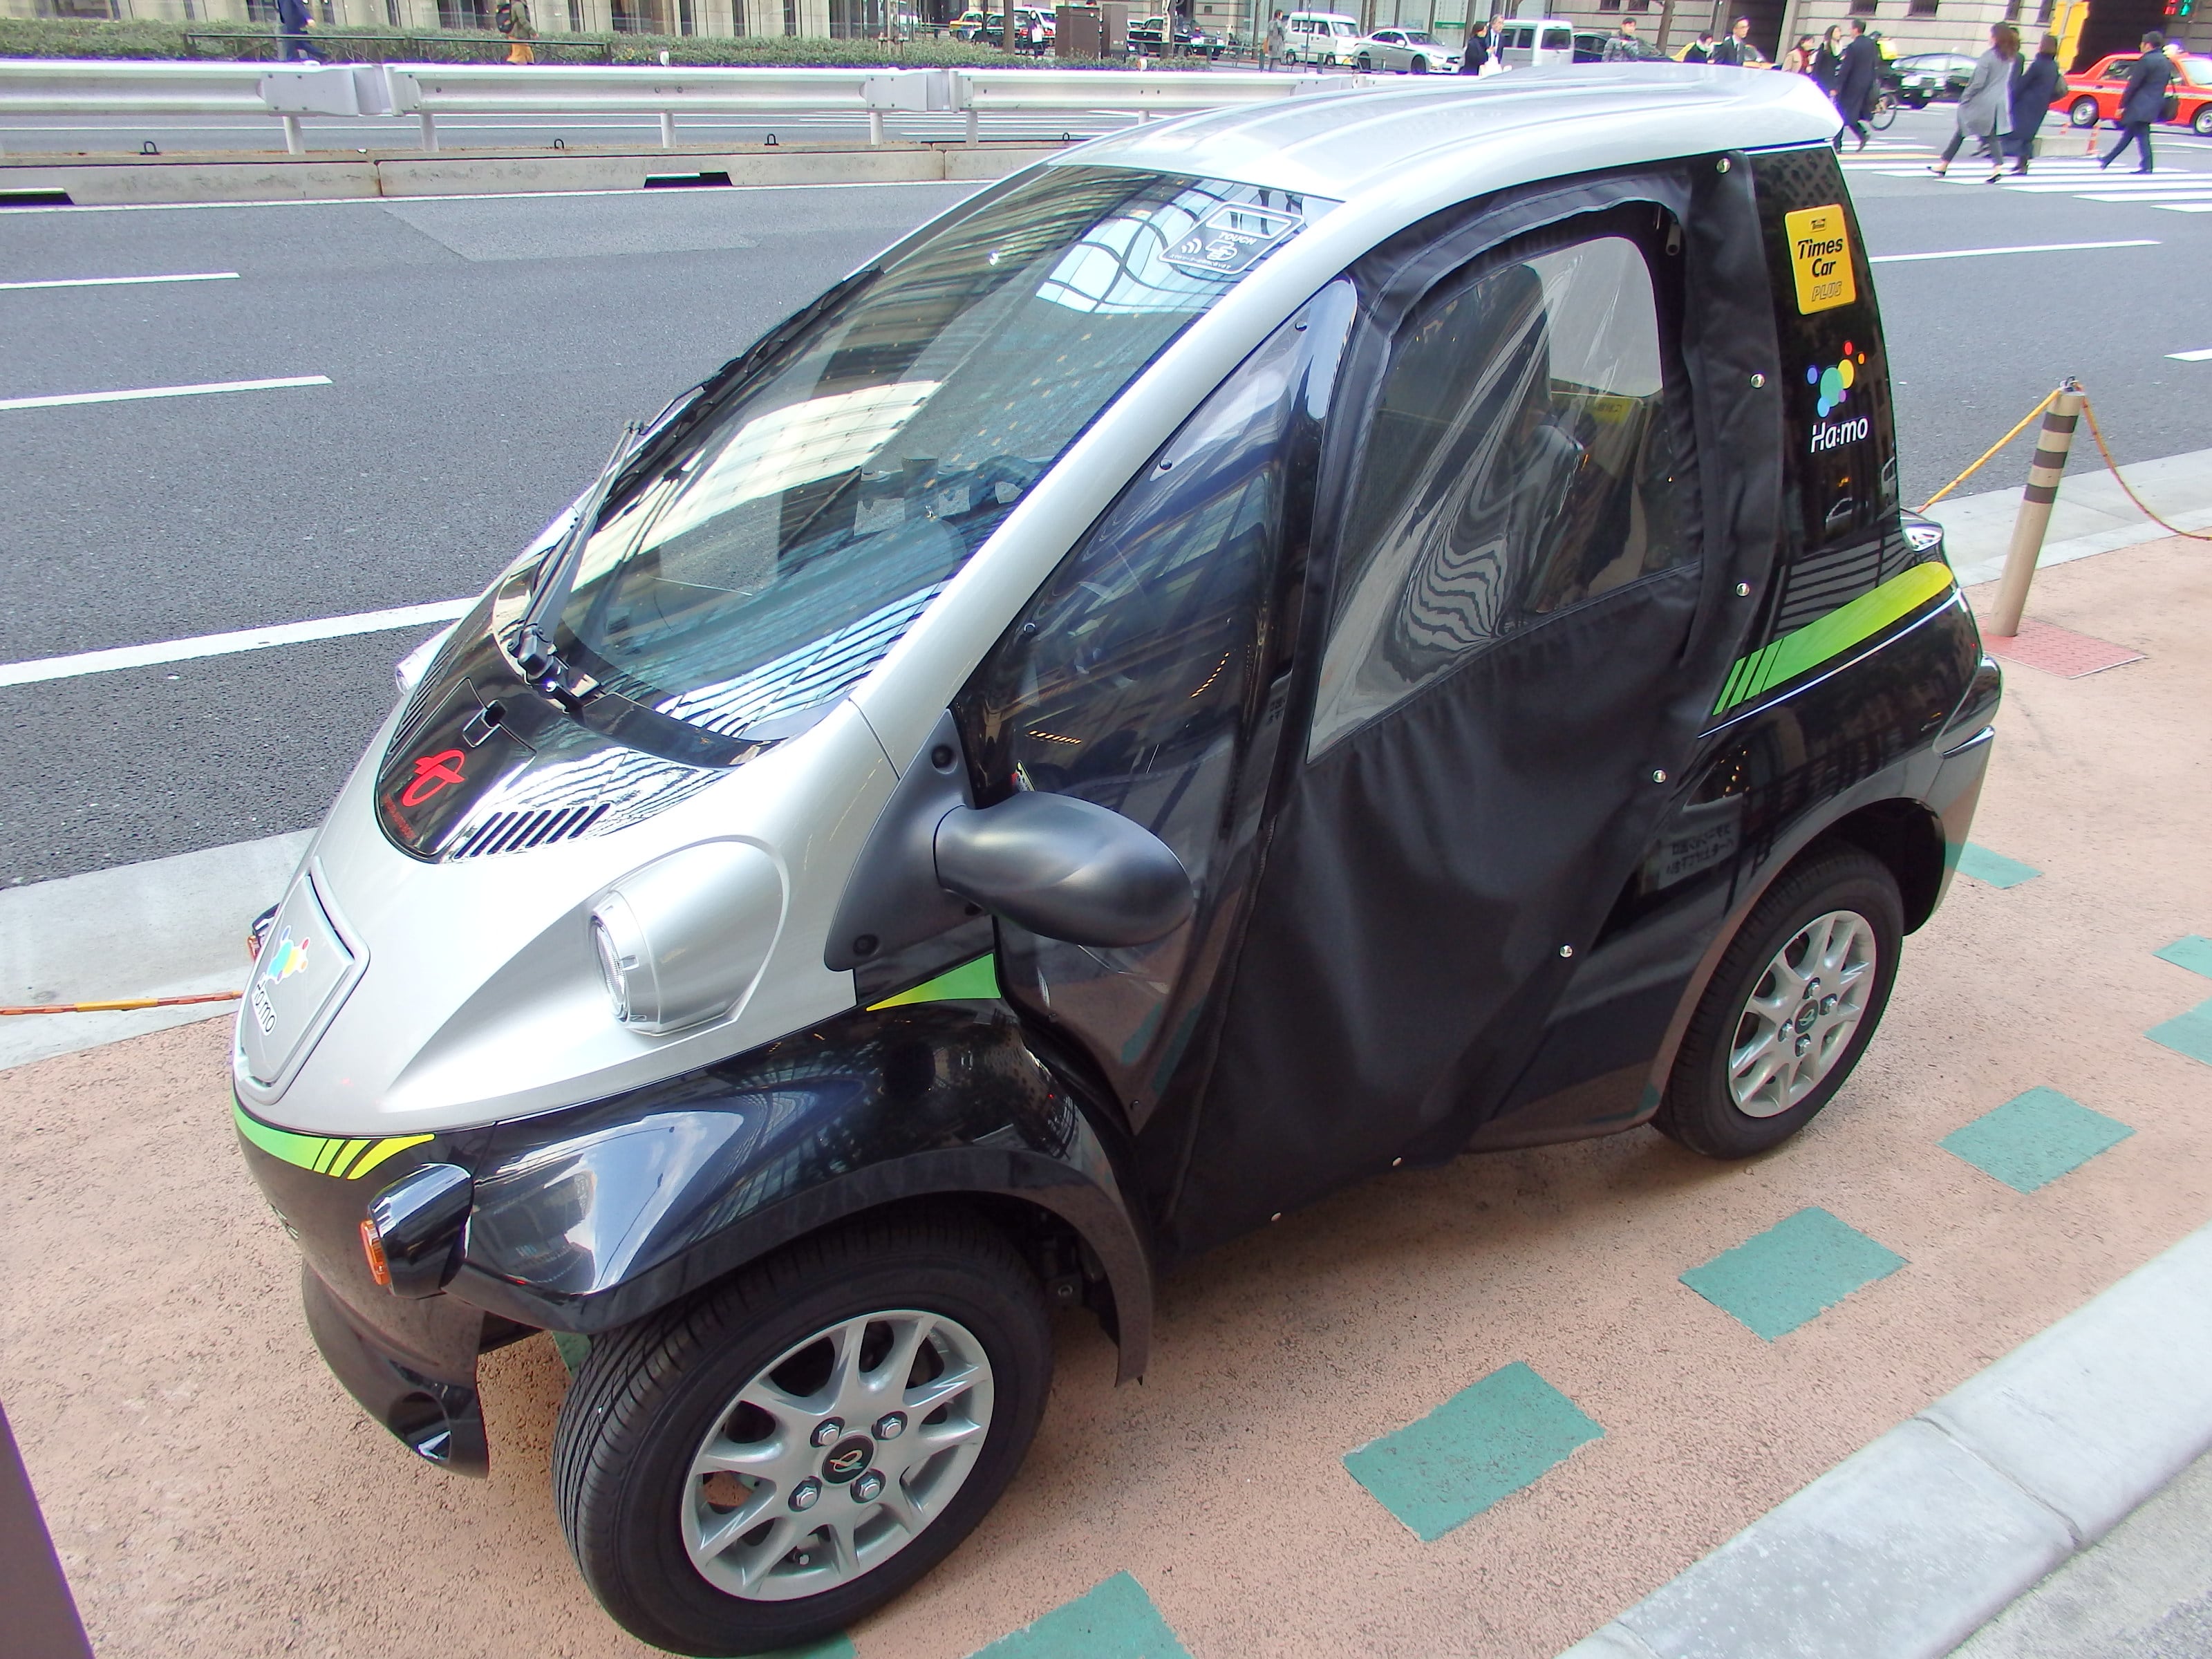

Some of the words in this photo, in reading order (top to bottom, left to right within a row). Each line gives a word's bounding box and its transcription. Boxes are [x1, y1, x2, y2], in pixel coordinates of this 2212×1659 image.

[1219, 232, 1257, 245] TOUCH
[1797, 238, 1843, 260] Times
[1812, 259, 1837, 277] Car
[1811, 281, 1842, 301] PLUS
[1811, 418, 1868, 453] Ha:mo
